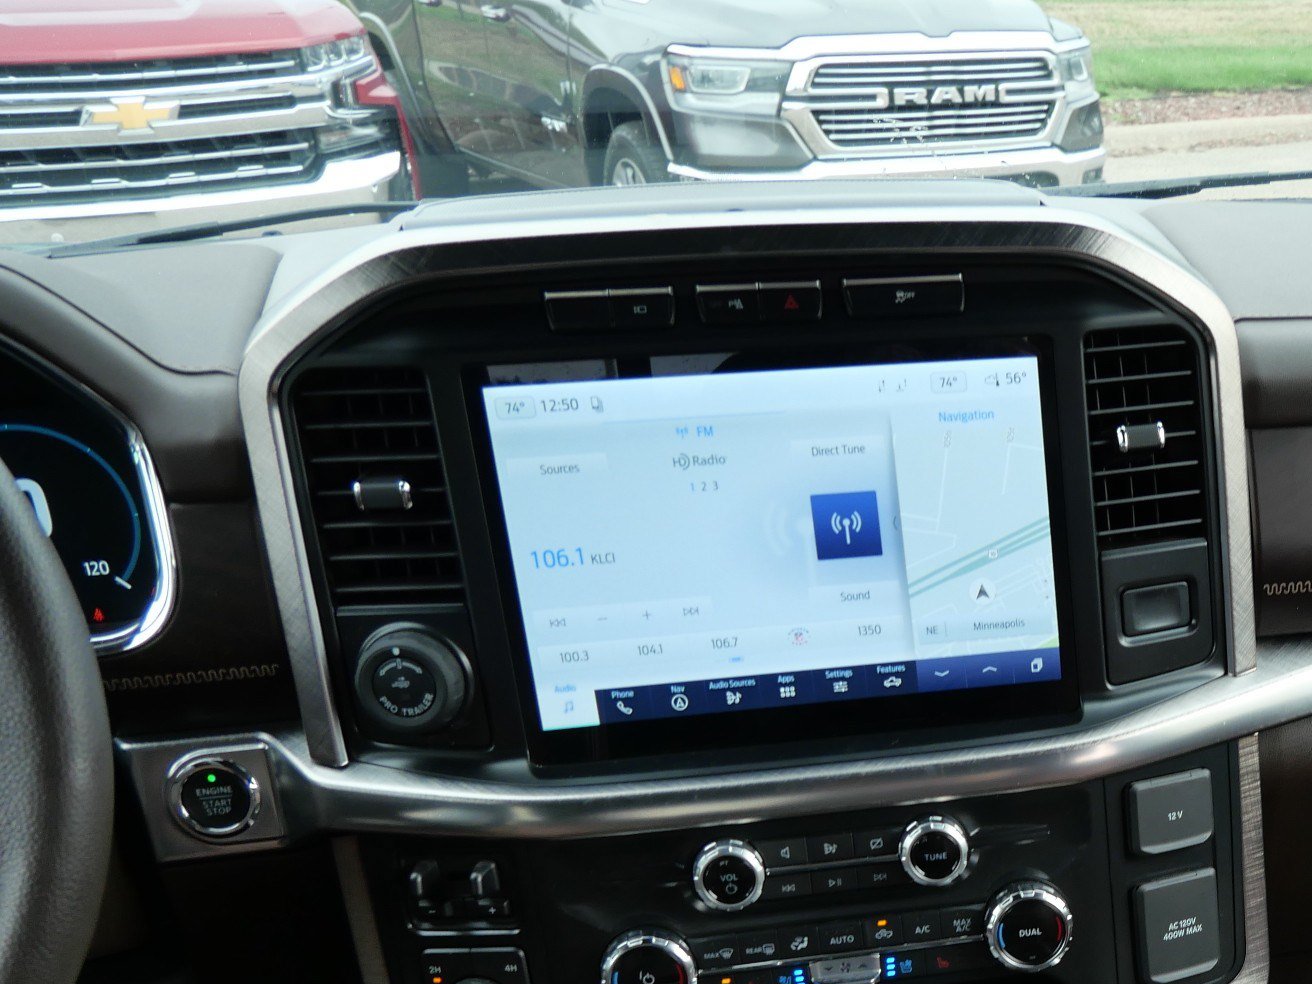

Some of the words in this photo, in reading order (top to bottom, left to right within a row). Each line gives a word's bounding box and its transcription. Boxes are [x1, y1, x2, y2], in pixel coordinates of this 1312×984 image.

[893, 84, 998, 106] RAM
[540, 398, 579, 413] 12:50
[938, 410, 995, 423] Navigation
[696, 425, 714, 438] FM
[810, 444, 839, 457] Direct
[842, 443, 866, 455] Tune
[692, 453, 726, 467] Radio
[540, 463, 580, 476] Sources
[530, 546, 585, 570] 106.1
[590, 552, 616, 565] KLCI
[83, 560, 110, 577] 120
[840, 590, 871, 602] Sound
[857, 624, 882, 637] 1350
[925, 625, 939, 636] NE
[973, 618, 1026, 632] Minneapolis
[711, 637, 739, 650] 106.7
[559, 650, 589, 664] 100.3
[637, 644, 664, 657] 104.1
[825, 668, 853, 681] Settings
[876, 664, 906, 676] Features
[708, 679, 729, 691] Audio
[729, 677, 756, 690] Sources
[777, 673, 795, 685] Apps
[554, 683, 577, 695] Audio
[611, 689, 635, 700] Phone
[670, 684, 686, 695] Nav
[379, 696, 398, 714] PRO
[402, 692, 434, 717] TRAILER
[195, 785, 233, 797] ENGINE
[203, 798, 232, 809] START
[206, 806, 232, 816] STOP
[924, 852, 948, 862] TUNE
[719, 873, 738, 882] VOL
[915, 924, 931, 935] A/C
[1167, 920, 1179, 932] AC
[1178, 916, 1197, 930] 120V
[1018, 927, 1042, 939] DUAL
[1162, 927, 1185, 942] 400W
[1186, 923, 1203, 937] MAX
[829, 934, 855, 946] AUTO
[428, 965, 442, 975] 2H
[504, 964, 518, 973] 4H
